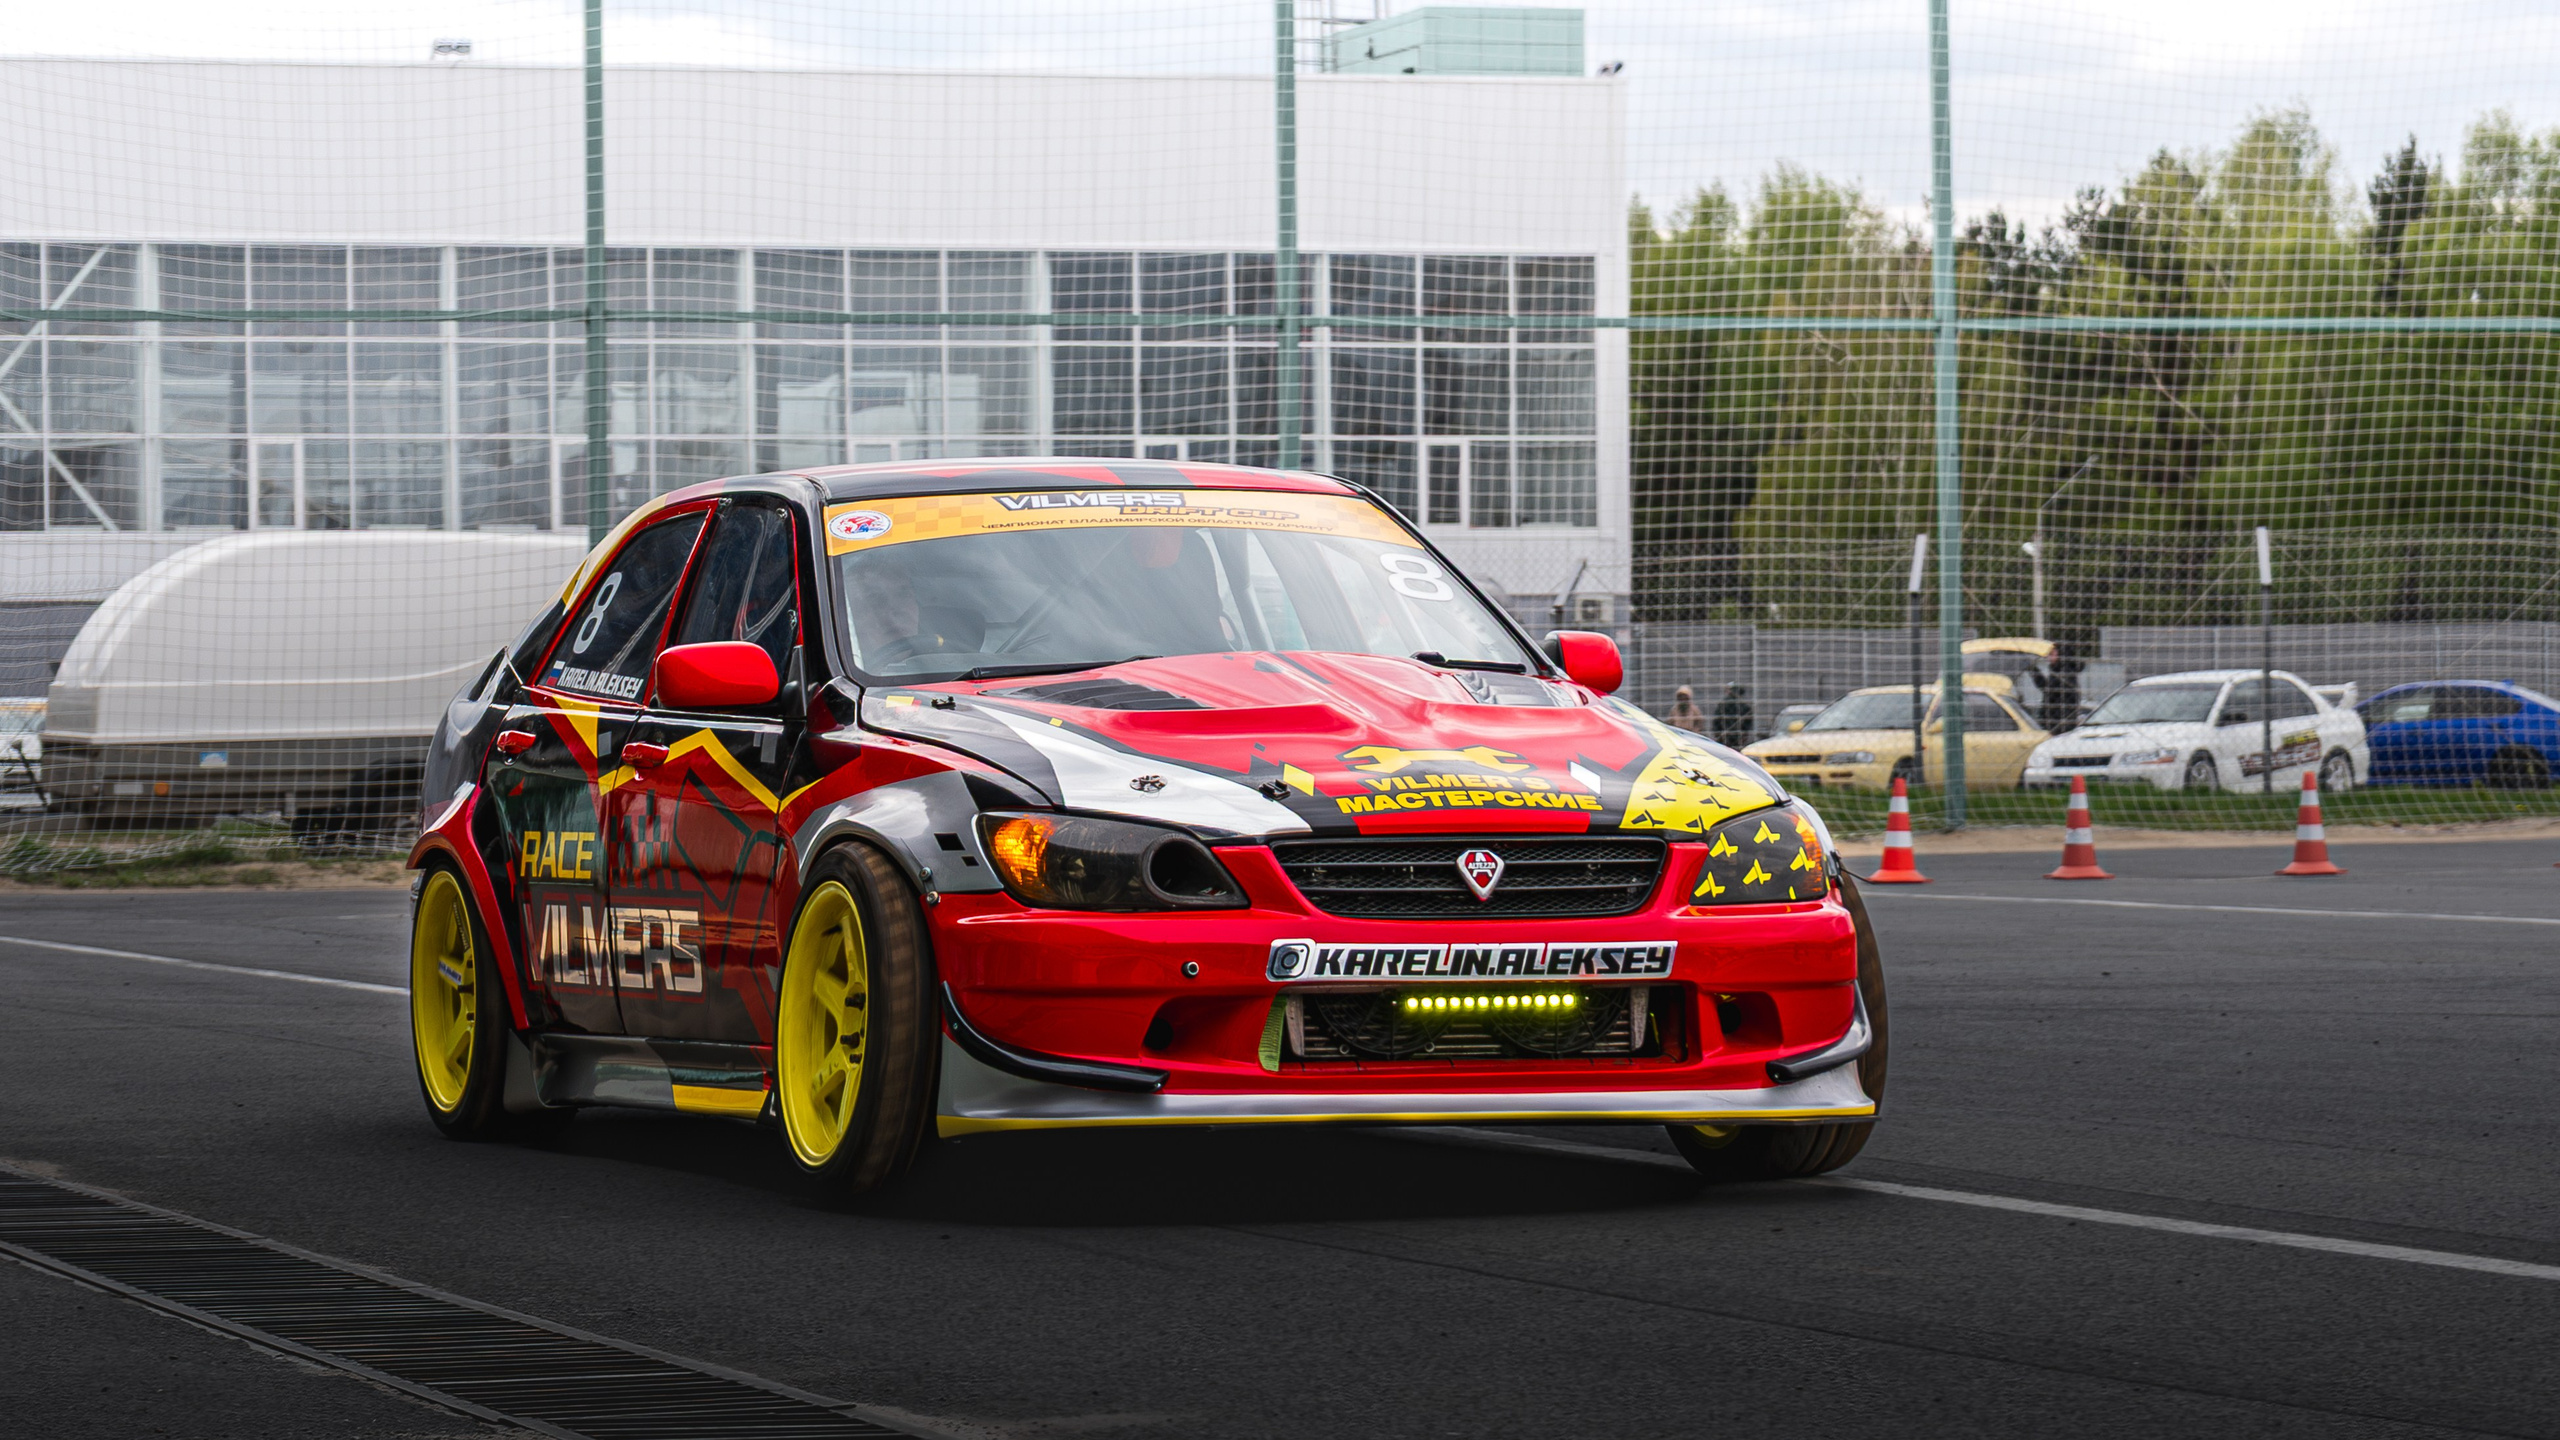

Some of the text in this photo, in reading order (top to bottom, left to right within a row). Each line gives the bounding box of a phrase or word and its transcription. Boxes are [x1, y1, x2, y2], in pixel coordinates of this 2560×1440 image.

[997, 491, 1184, 511] VILMERS
[1120, 505, 1299, 521] DRIFT CUP
[981, 519, 1066, 529] ЧЕМПИОНАТ
[1069, 516, 1185, 525] ВЛАДИМИРСКОЙ
[1188, 517, 1253, 526] ОБЛАСТИ
[1277, 522, 1334, 532] ДРИФТУ
[1380, 552, 1454, 602] 8
[573, 571, 622, 654] 8
[1364, 774, 1552, 792] VILMER'S
[1335, 790, 1604, 815] МАСТЕРСКИЕ
[520, 830, 596, 880] RACE
[522, 902, 703, 993] VILMERS
[1314, 945, 1672, 977] KARELIN.ALEKSEY
